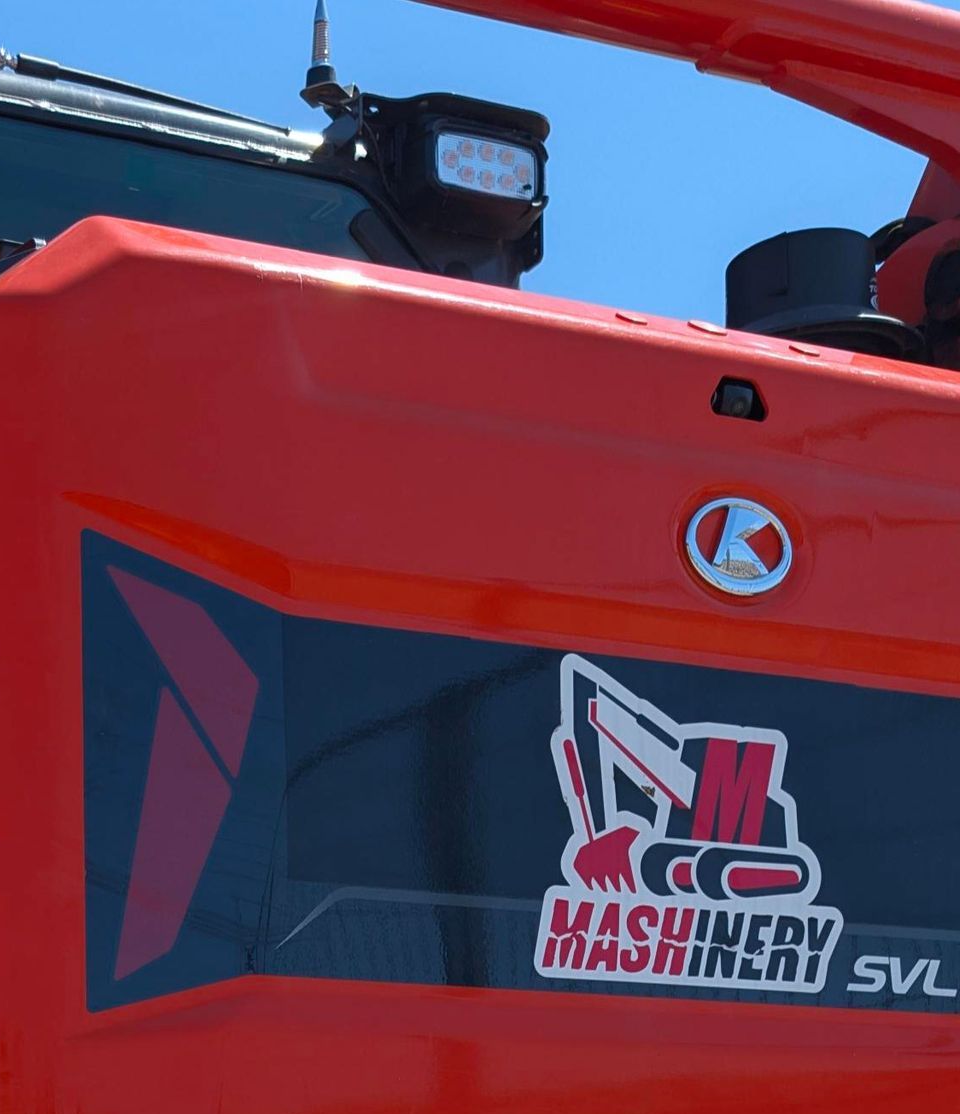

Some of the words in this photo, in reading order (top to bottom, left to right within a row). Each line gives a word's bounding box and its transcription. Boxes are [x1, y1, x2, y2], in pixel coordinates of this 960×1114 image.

[691, 737, 776, 845] M
[542, 898, 836, 984] MASHINERY
[846, 954, 958, 998] SVL
